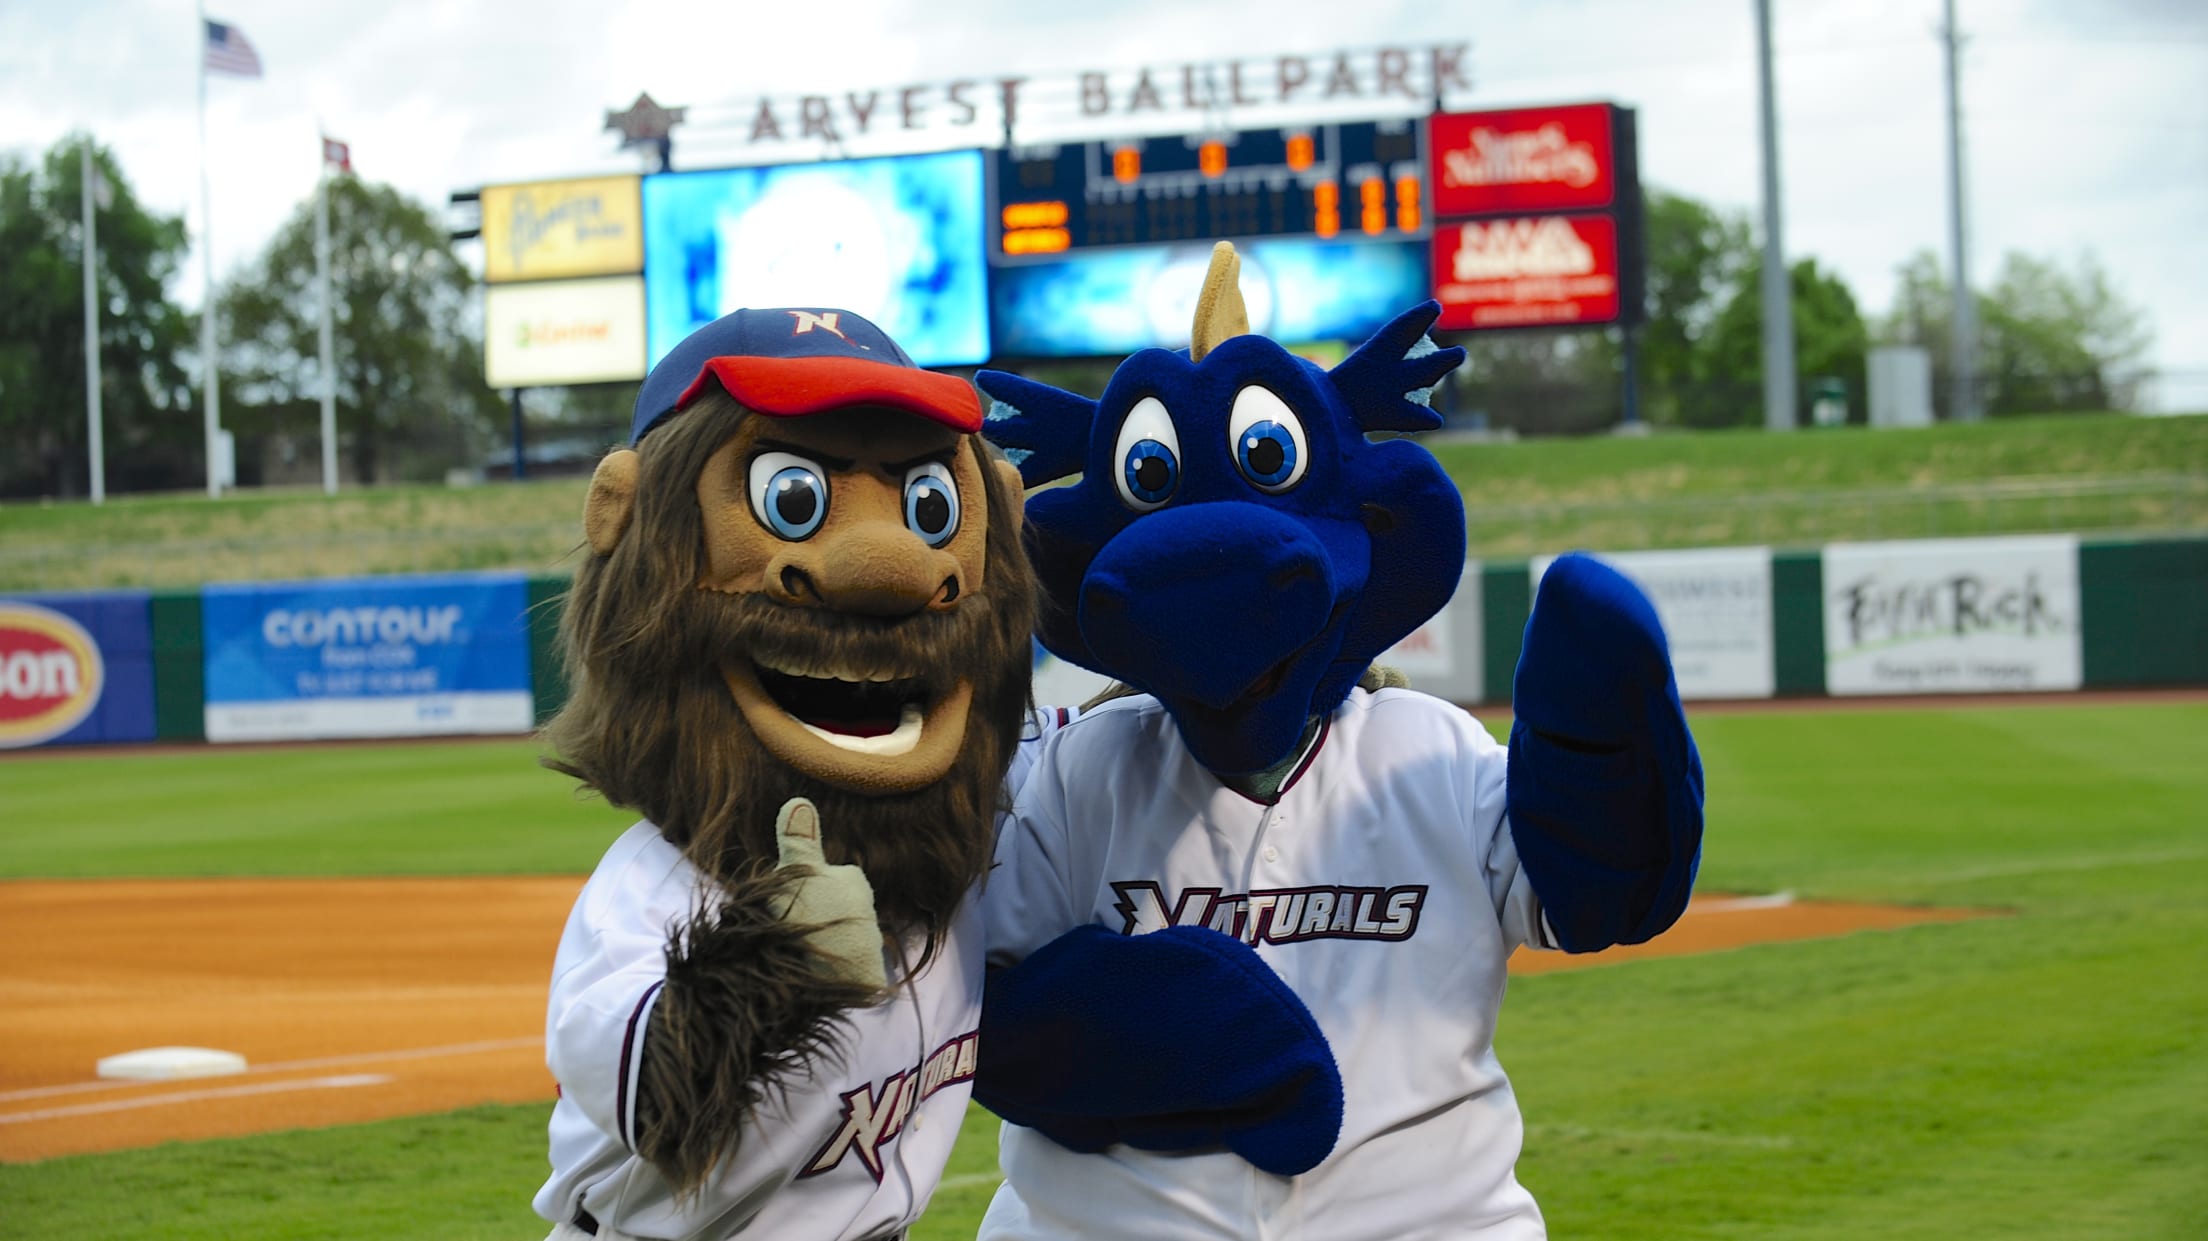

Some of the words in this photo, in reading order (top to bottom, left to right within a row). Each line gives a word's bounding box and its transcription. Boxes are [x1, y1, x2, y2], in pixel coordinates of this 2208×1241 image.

[747, 76, 1028, 142] ARVEST
[1080, 41, 1472, 115] BALLPARK
[785, 311, 858, 347] N
